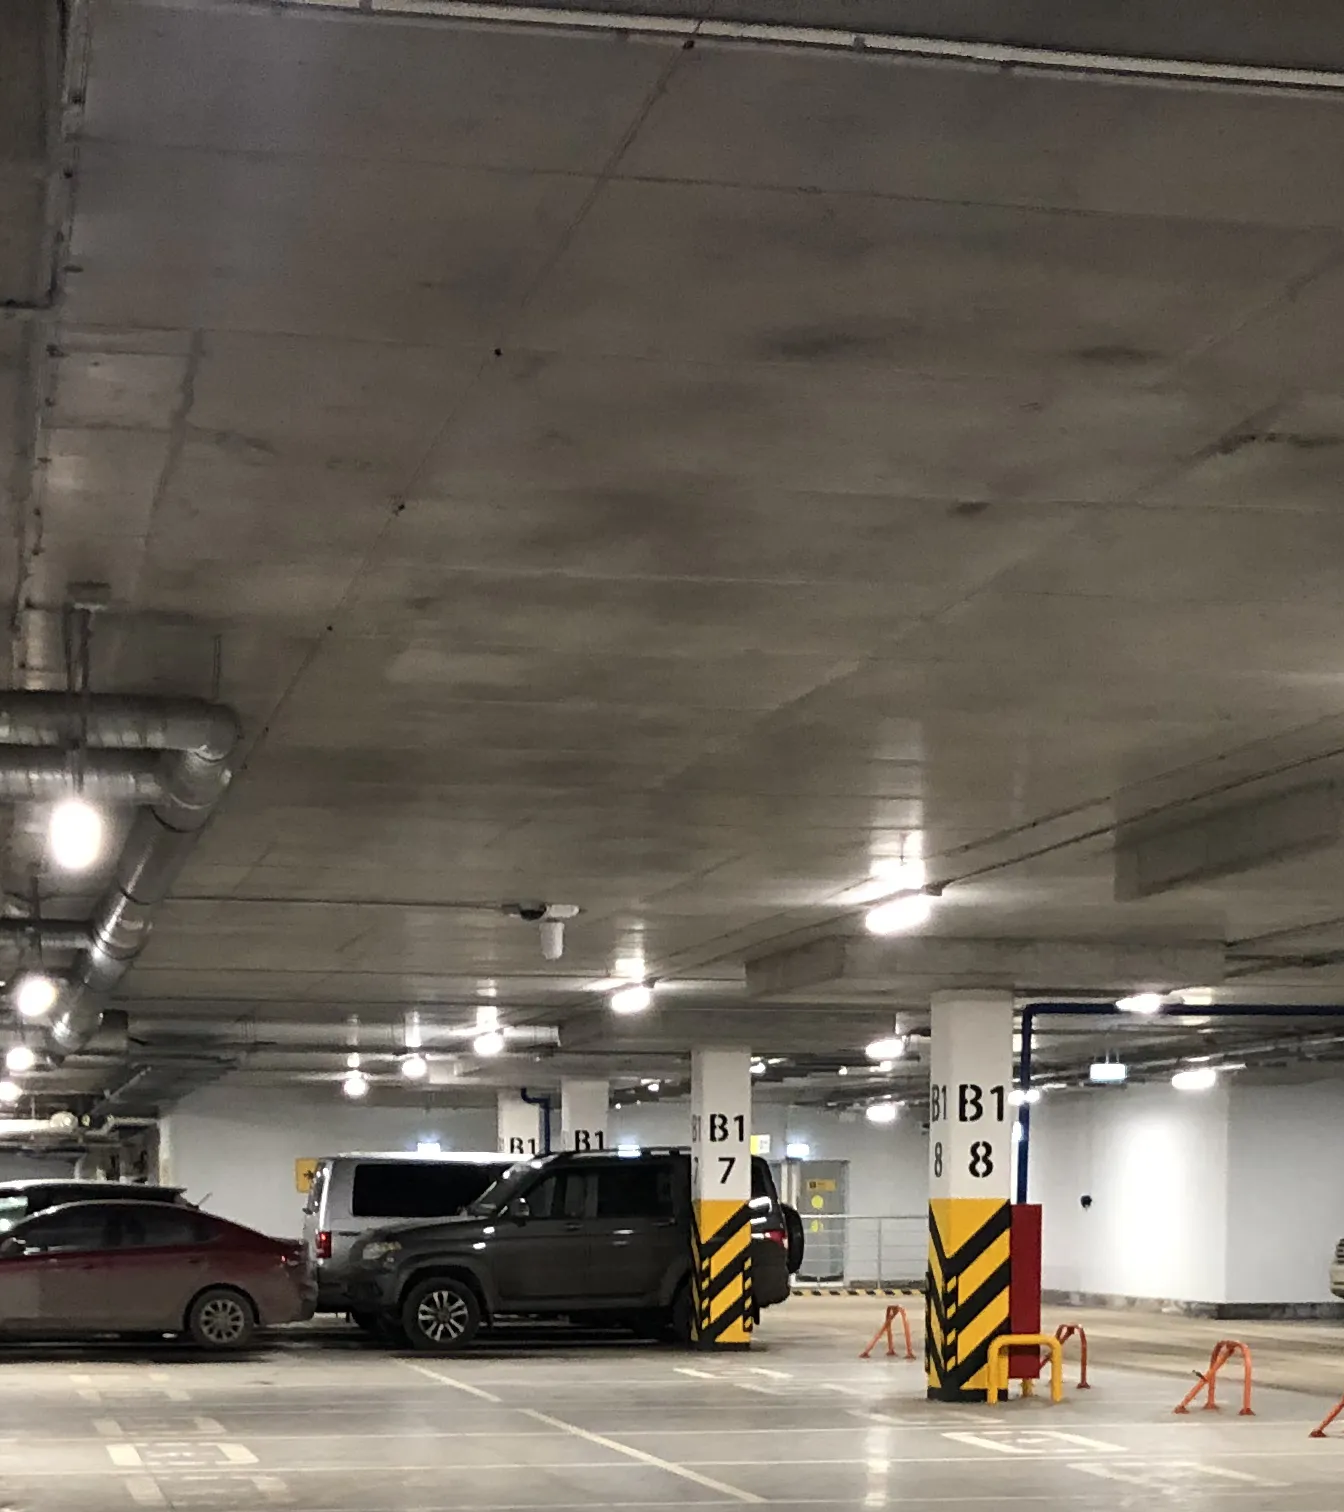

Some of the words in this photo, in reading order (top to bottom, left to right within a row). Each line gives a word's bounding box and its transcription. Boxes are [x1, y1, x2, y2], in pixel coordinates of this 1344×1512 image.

[931, 1084, 947, 1121] B1
[959, 1084, 1004, 1122] B1
[575, 1129, 604, 1153] B1
[709, 1113, 745, 1142] B1
[510, 1137, 536, 1154] B1
[934, 1142, 943, 1177] 8
[968, 1141, 994, 1178] 8
[718, 1157, 736, 1184] 7
